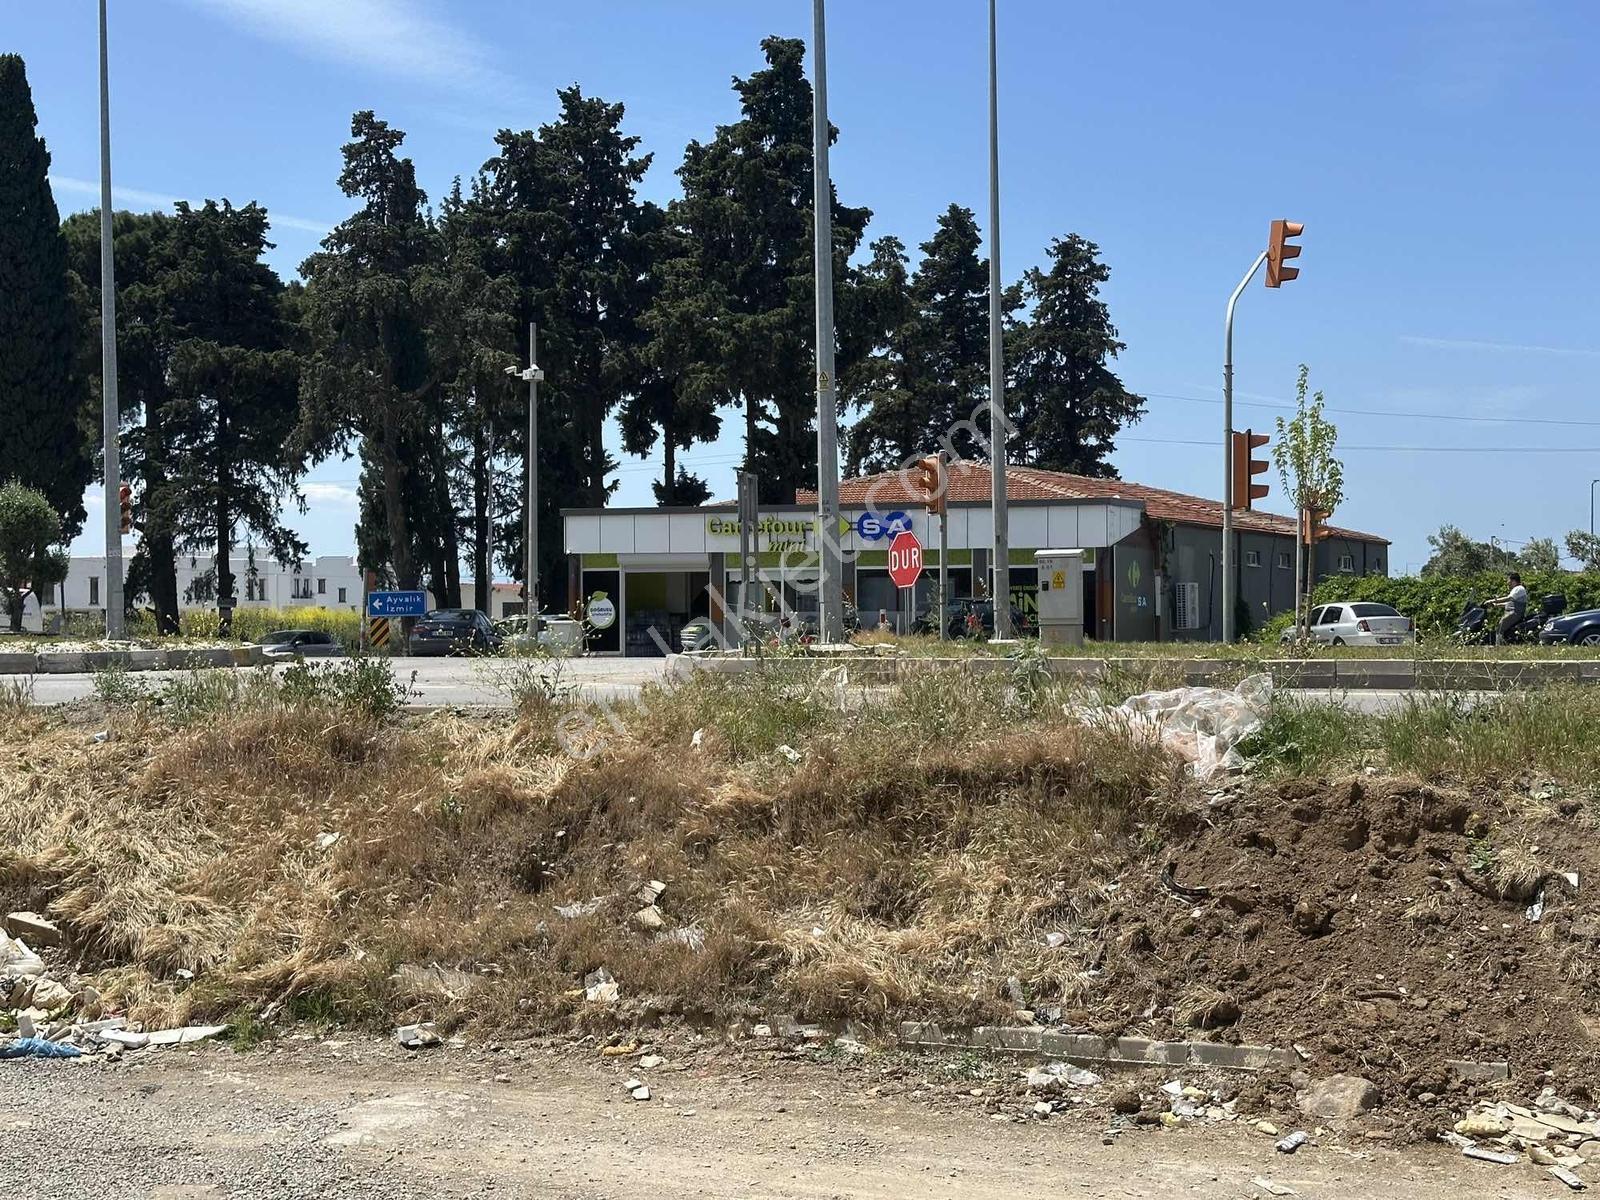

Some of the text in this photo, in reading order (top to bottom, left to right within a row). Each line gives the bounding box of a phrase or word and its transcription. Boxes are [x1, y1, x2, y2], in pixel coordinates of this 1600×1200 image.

[861, 516, 909, 536] SA
[891, 547, 919, 572] DUR
[386, 595, 422, 604] Ayvalık
[386, 604, 414, 612] İzmir
